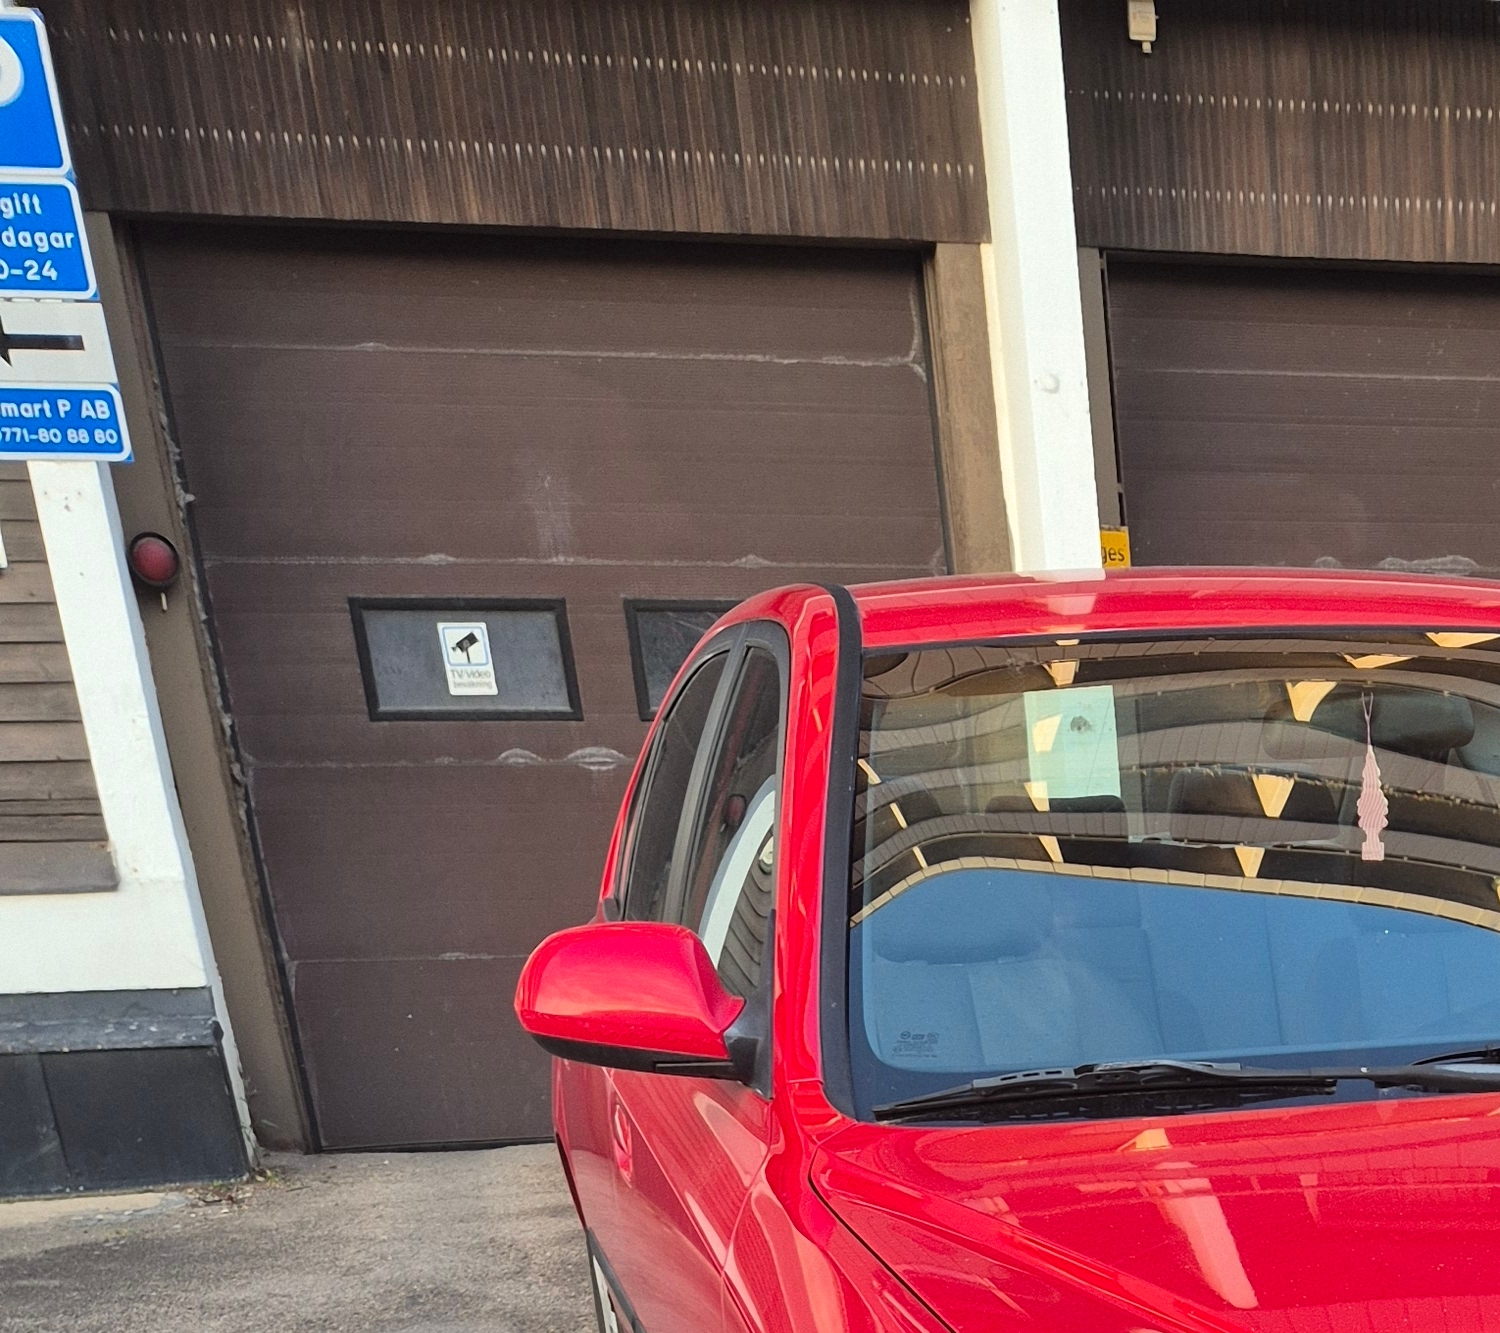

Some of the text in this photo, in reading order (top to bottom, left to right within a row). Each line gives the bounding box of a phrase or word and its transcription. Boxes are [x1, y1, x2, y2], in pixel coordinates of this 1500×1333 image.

[1, 226, 75, 253] dagar
[0, 398, 111, 420] mart P AB
[0, 427, 62, 443] 771-80
